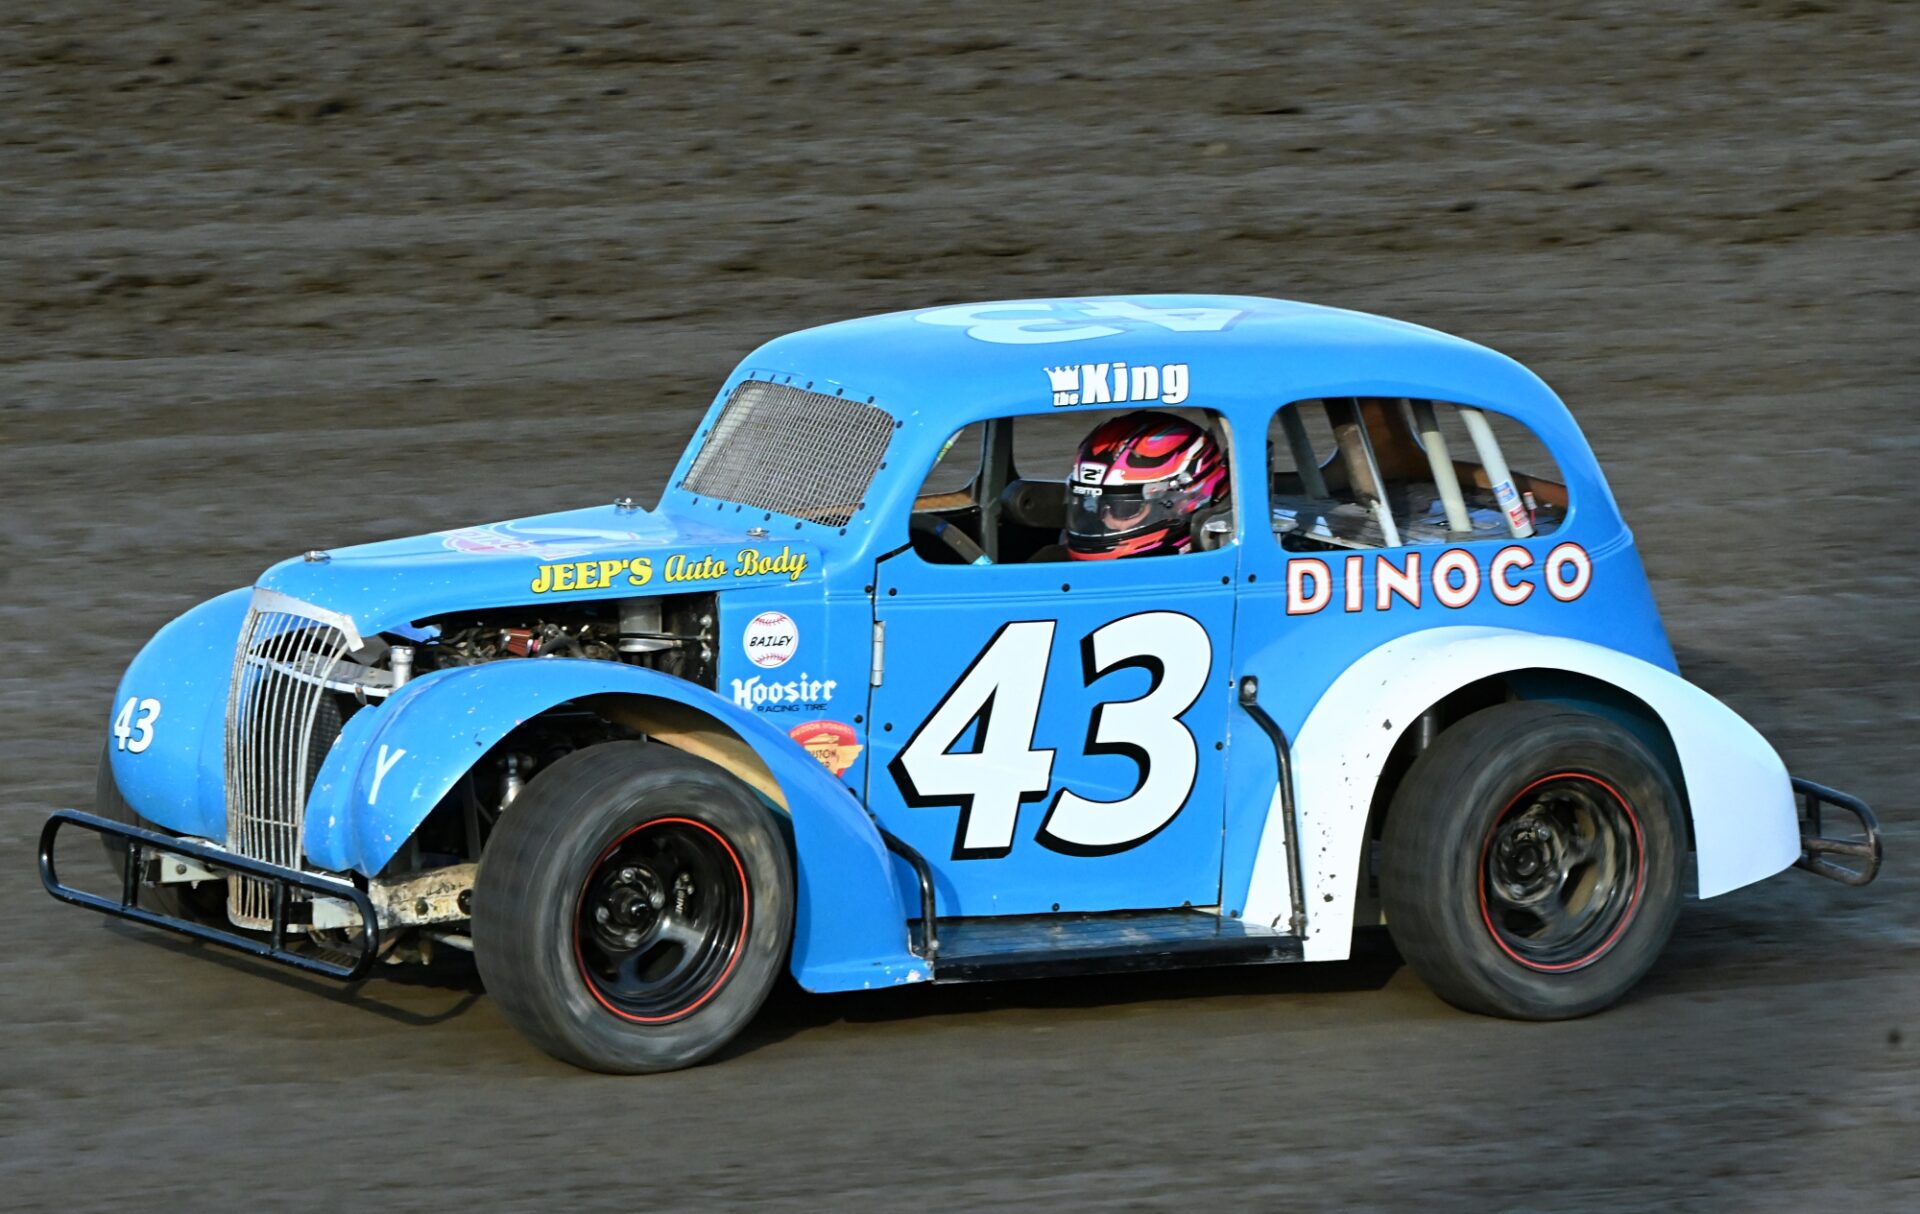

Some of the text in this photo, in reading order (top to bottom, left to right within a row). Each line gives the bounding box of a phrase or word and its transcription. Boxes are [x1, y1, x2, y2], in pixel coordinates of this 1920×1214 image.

[1053, 361, 1190, 407] the King
[530, 545, 808, 594] JEEP'S Auto Body
[1286, 542, 1592, 615] DINOCO
[749, 635, 794, 647] BAILEY
[730, 672, 837, 710] Hoosier
[757, 703, 827, 712] RACING TIRE
[113, 696, 161, 754] 43
[887, 609, 1213, 861] 43
[367, 744, 407, 805] Y
